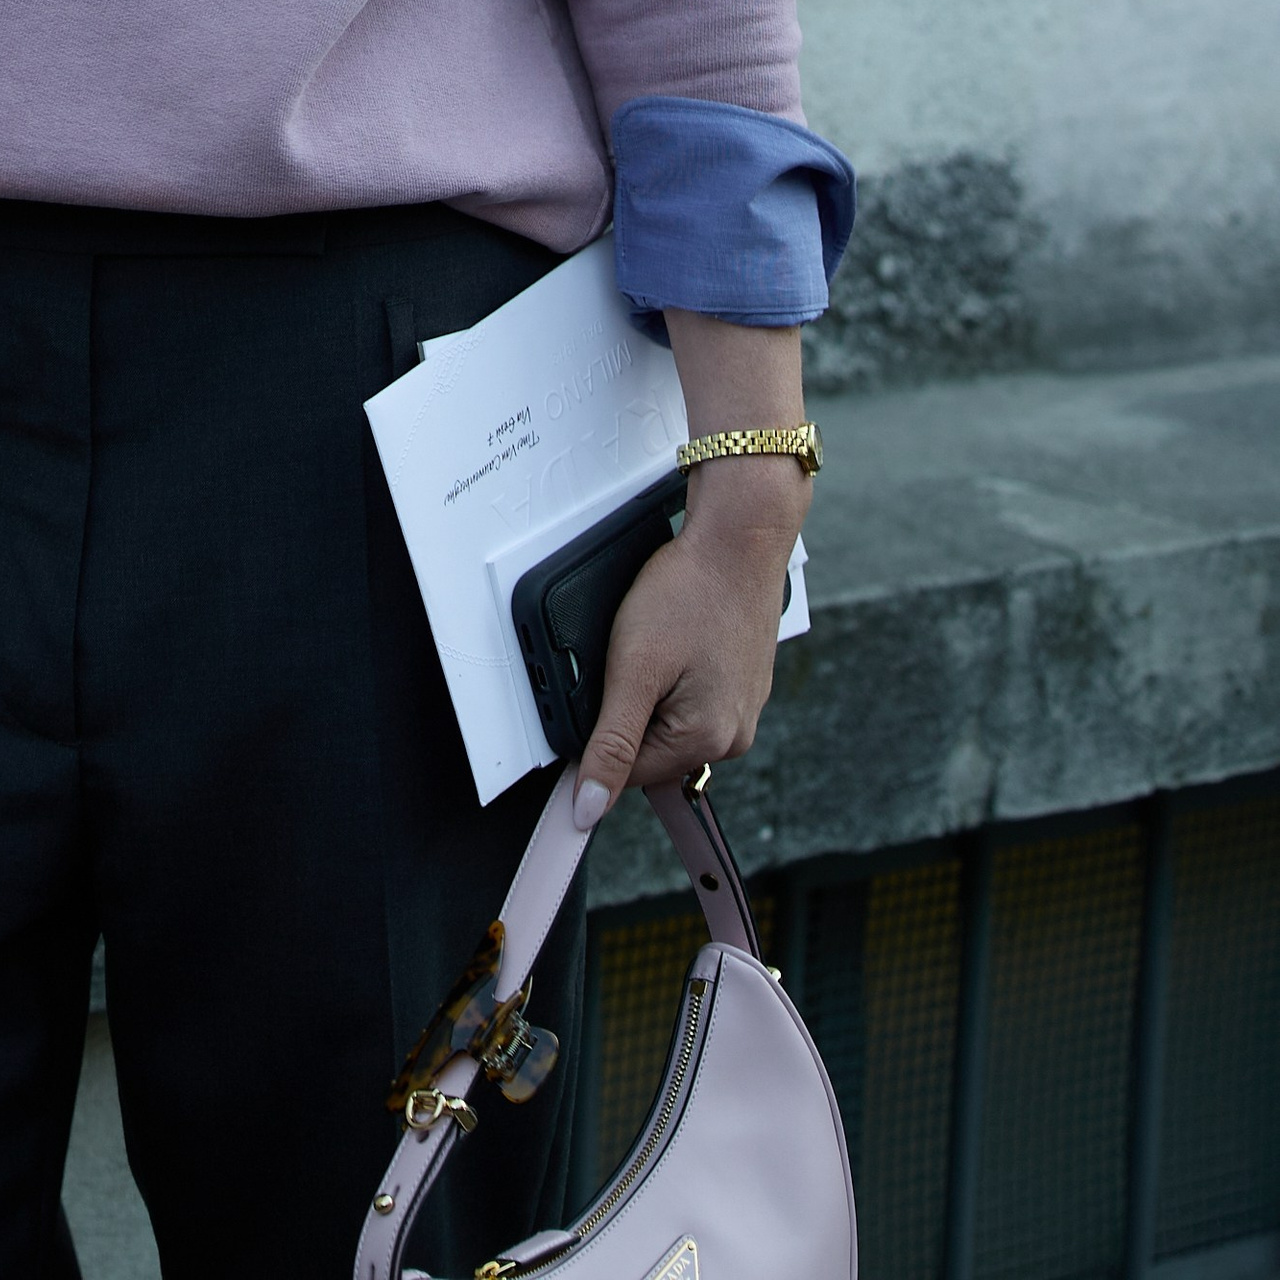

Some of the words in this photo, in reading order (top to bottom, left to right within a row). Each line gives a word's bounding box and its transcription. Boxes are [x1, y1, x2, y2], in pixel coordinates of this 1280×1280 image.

[517, 405, 532, 426] Via
[544, 339, 633, 420] MILANO
[491, 381, 688, 533] RADA
